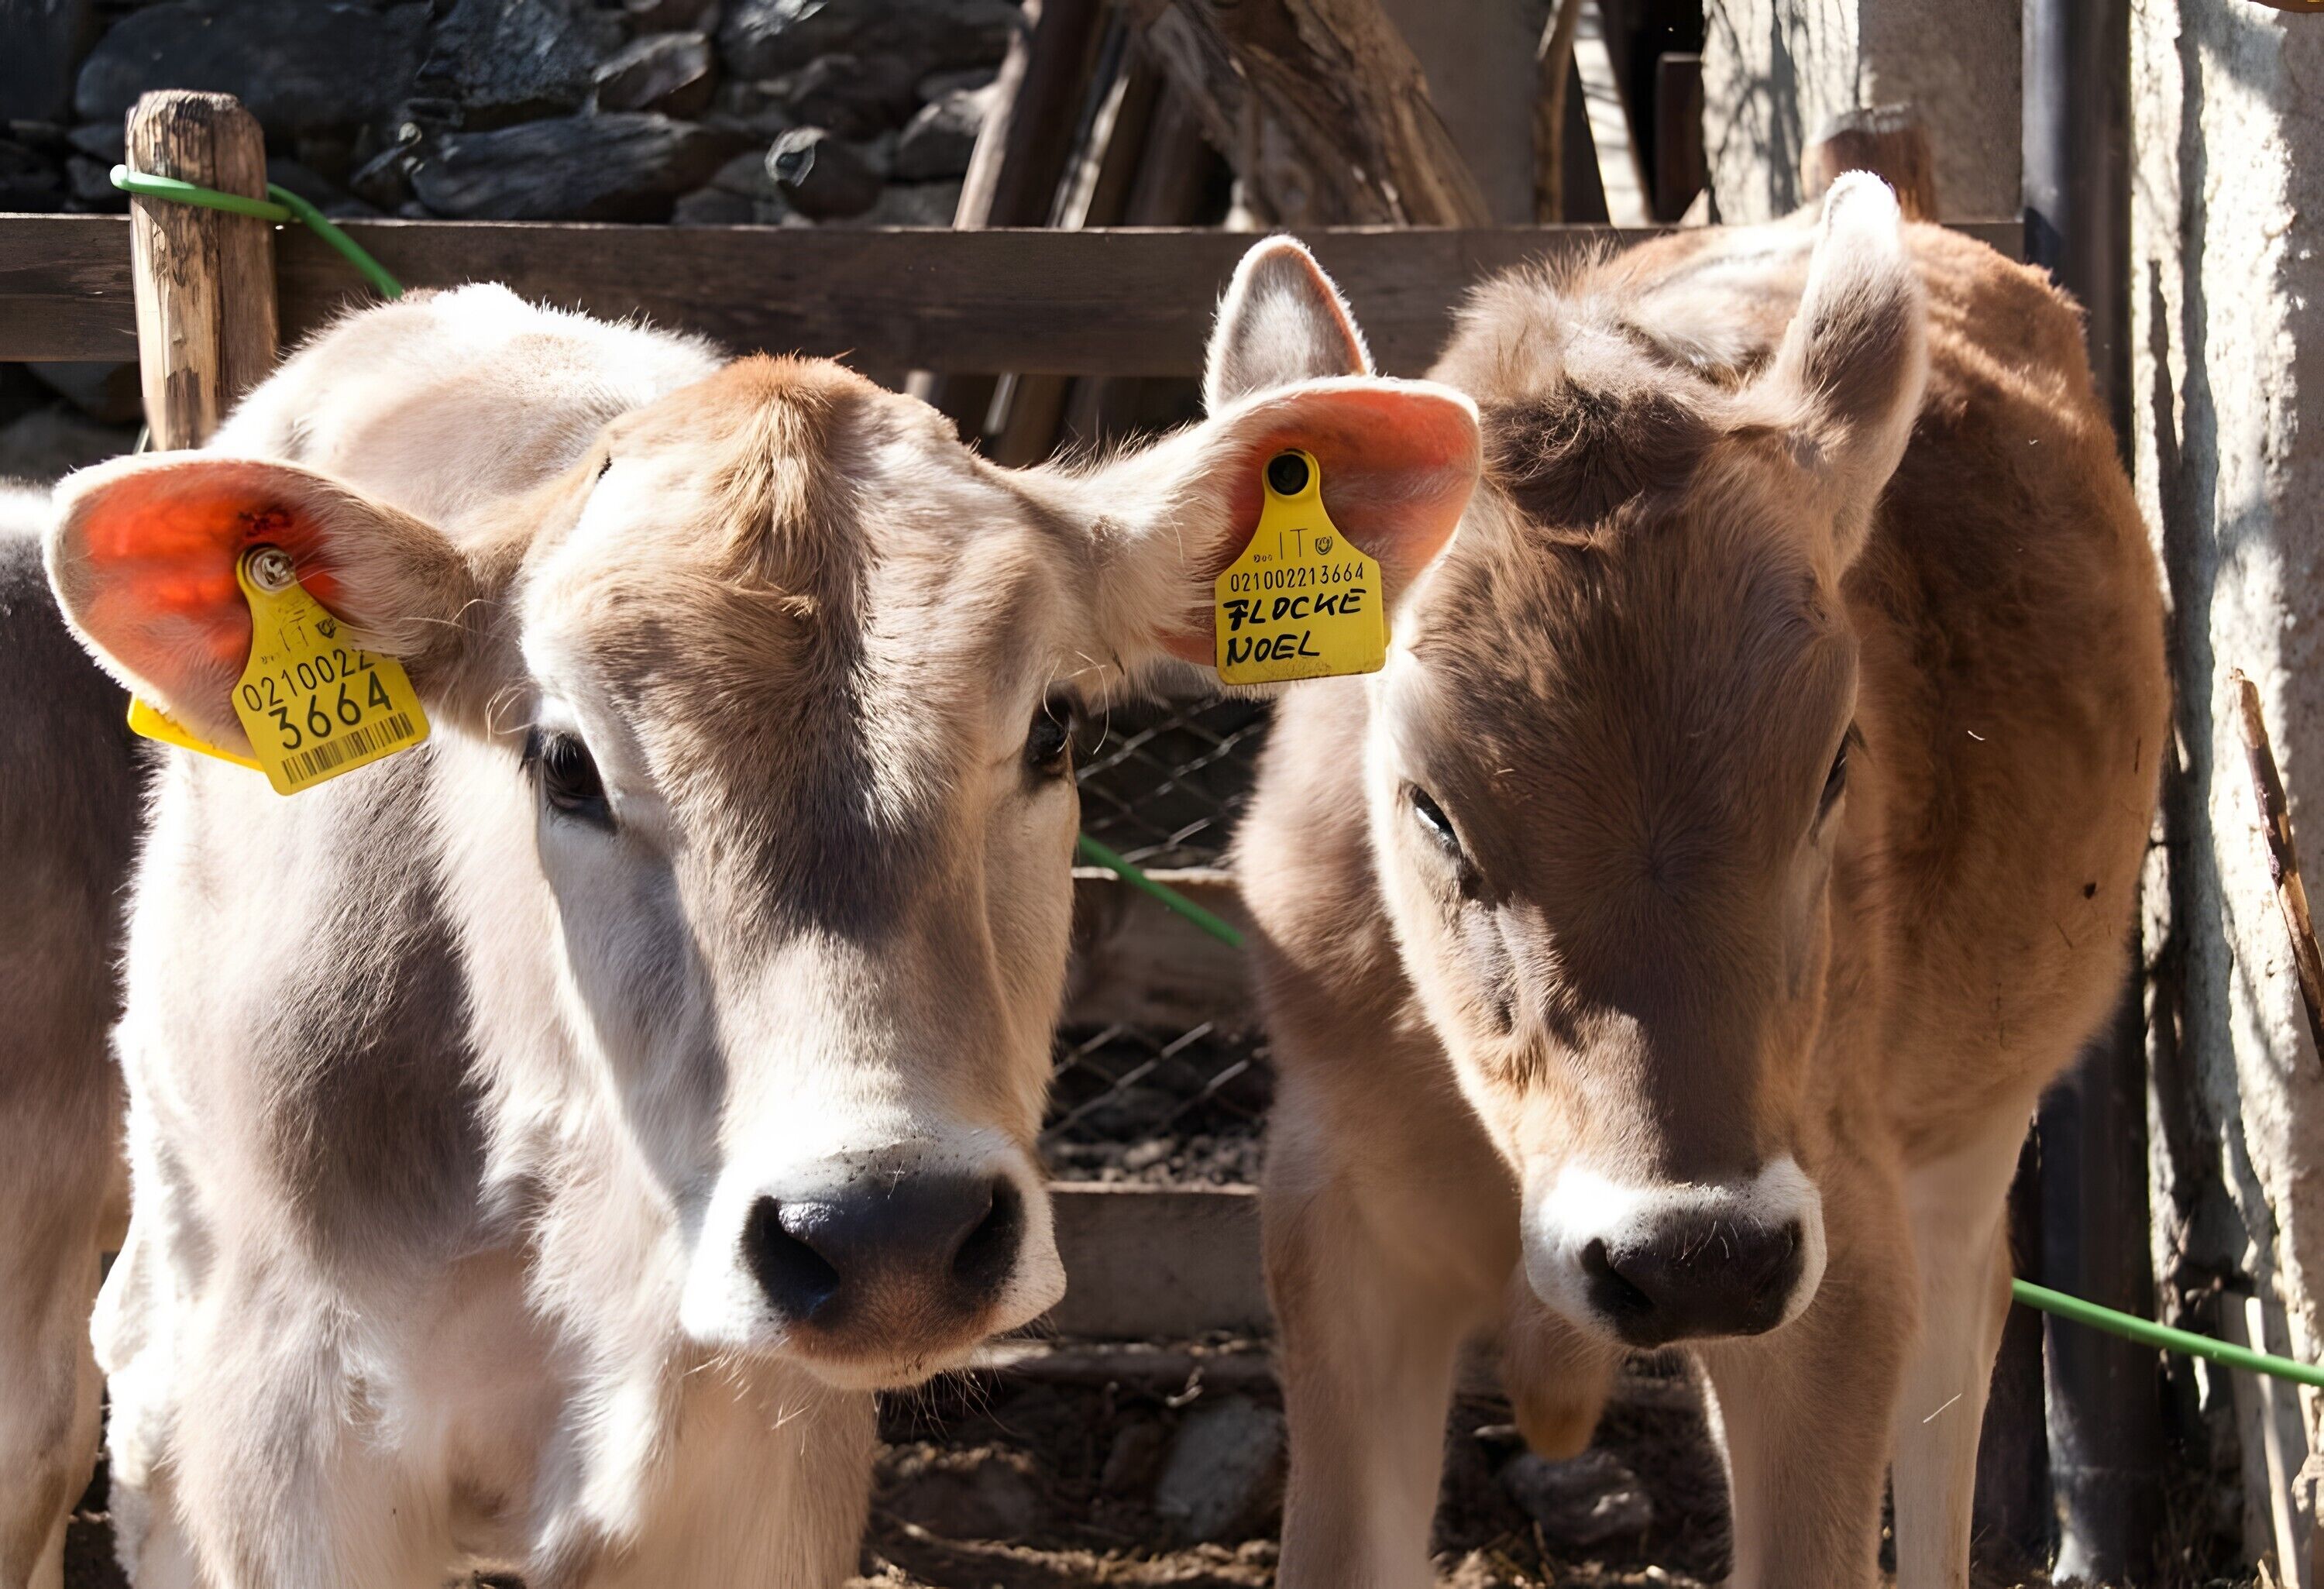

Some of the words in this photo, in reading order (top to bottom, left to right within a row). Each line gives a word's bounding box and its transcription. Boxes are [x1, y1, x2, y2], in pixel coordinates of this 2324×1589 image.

[1279, 528, 1308, 560] IT
[1230, 562, 1363, 593] 021002213664
[1222, 588, 1367, 631] FLOCKE
[1226, 630, 1320, 666] NOEL
[268, 670, 393, 750] 3664
